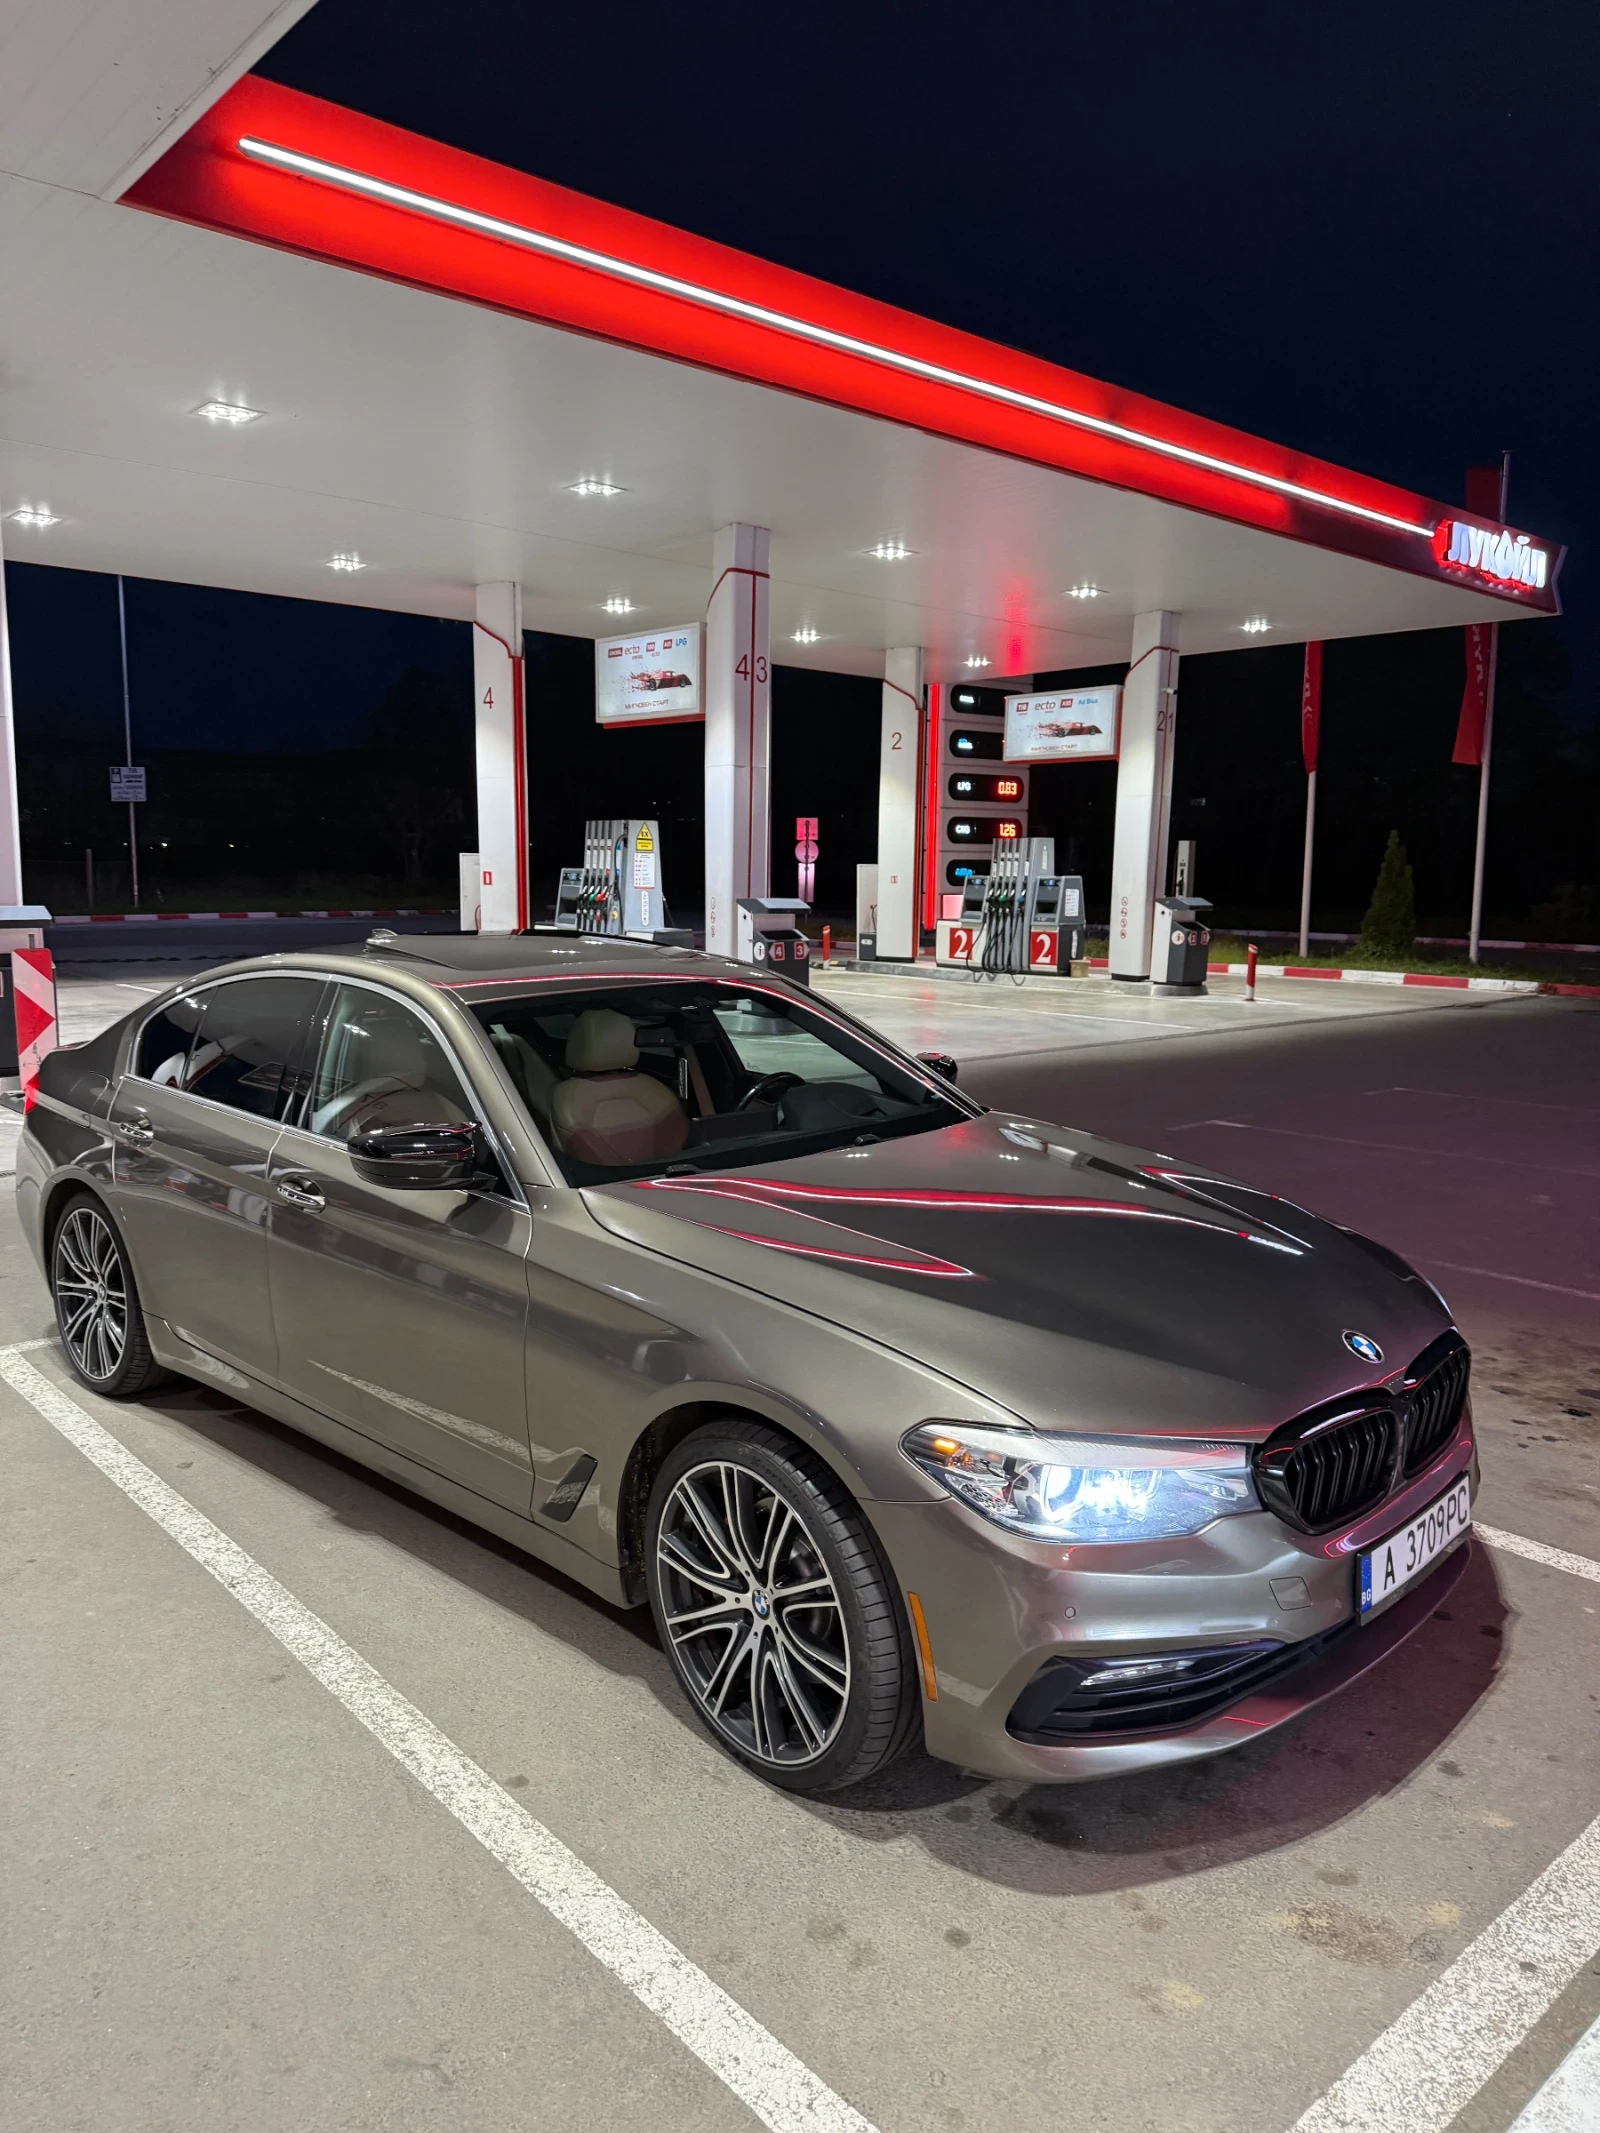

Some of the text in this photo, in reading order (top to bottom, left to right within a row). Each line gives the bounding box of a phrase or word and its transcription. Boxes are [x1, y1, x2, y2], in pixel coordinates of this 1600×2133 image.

[1448, 521, 1546, 588] ЛУКОЙЛ
[624, 645, 640, 655] ecto
[675, 638, 687, 647] LPG
[735, 653, 767, 683] 4 3
[483, 686, 494, 709] 4
[1035, 700, 1056, 710] ecto
[1157, 710, 1165, 731] 2
[891, 731, 902, 750] 2
[775, 946, 783, 957] 4
[796, 945, 804, 956] 3
[954, 929, 968, 958] 2
[1035, 933, 1052, 964] 2
[1383, 1485, 1468, 1591] A 3709PC
[1361, 1588, 1372, 1605] BG
